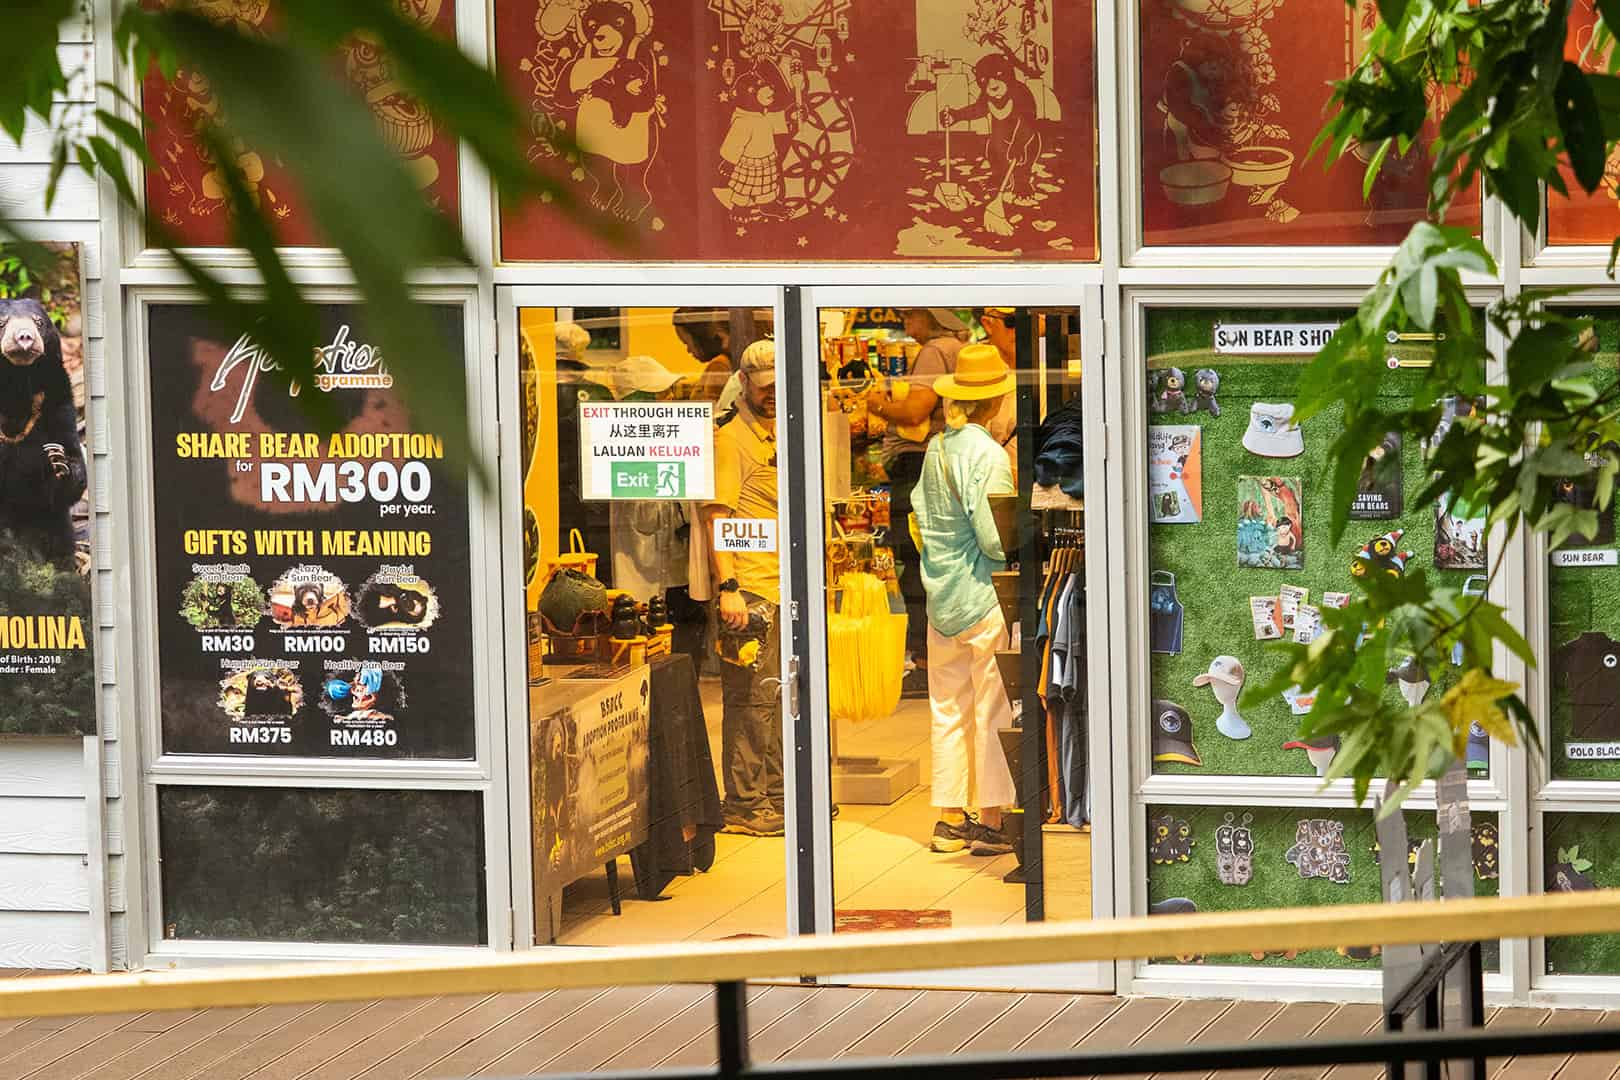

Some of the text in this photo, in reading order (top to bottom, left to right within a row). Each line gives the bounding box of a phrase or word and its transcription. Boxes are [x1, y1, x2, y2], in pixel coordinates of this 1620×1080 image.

[1254, 330, 1293, 346] BEAR
[1300, 329, 1335, 346] SHO
[583, 407, 710, 418] EXIT THROUGH HERE
[609, 424, 680, 438] 从这里离开
[176, 432, 443, 460] SHARE BEAR ADOPTION
[593, 446, 700, 457] LALUAN KELUAR
[235, 460, 431, 503] for RM300
[616, 472, 649, 488] Exit
[380, 504, 436, 516] per year.
[722, 522, 768, 539] PULL
[184, 529, 432, 556] GIFTS WITH MEANING
[724, 539, 751, 548] TARIK
[1562, 552, 1604, 563] SUN BEAR
[291, 574, 333, 582] Sun Bear
[202, 635, 255, 652] RM30
[284, 636, 346, 652] RM100
[368, 637, 431, 653] RM150
[0, 655, 10, 664] of
[25, 665, 56, 674] Female
[230, 726, 292, 743] RM375
[330, 729, 397, 746] RM480
[1570, 746, 1620, 757] POLO BLAC
